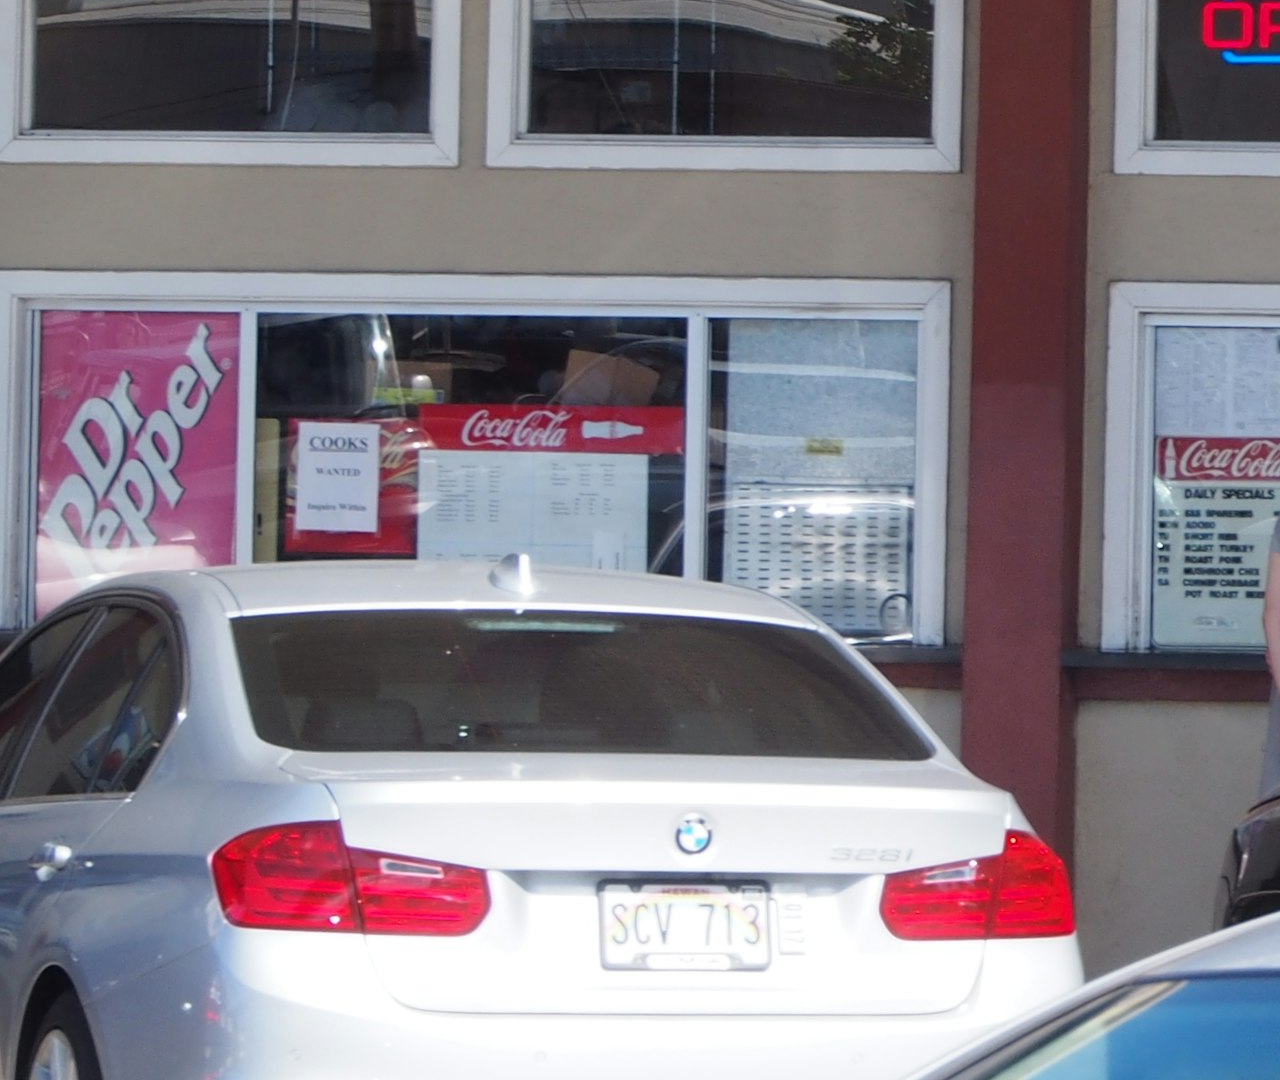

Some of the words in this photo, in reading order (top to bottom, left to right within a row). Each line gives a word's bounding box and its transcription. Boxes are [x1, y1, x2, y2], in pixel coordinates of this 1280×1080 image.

[461, 409, 572, 447] Coca-Cola
[62, 370, 145, 500] Dr
[308, 435, 369, 451] COOKS
[39, 322, 225, 588] Pepper
[315, 467, 362, 477] WANTED
[1184, 488, 1216, 499] DAILY
[1222, 488, 1275, 500] SPECIALS
[1185, 521, 1216, 529] ADOBO
[1184, 544, 1214, 552] ROAST
[1219, 544, 1254, 553] TURKEY
[1184, 556, 1214, 564] ROAST
[1184, 590, 1202, 598] POT
[611, 903, 673, 945] SCV
[697, 903, 761, 946] 713
